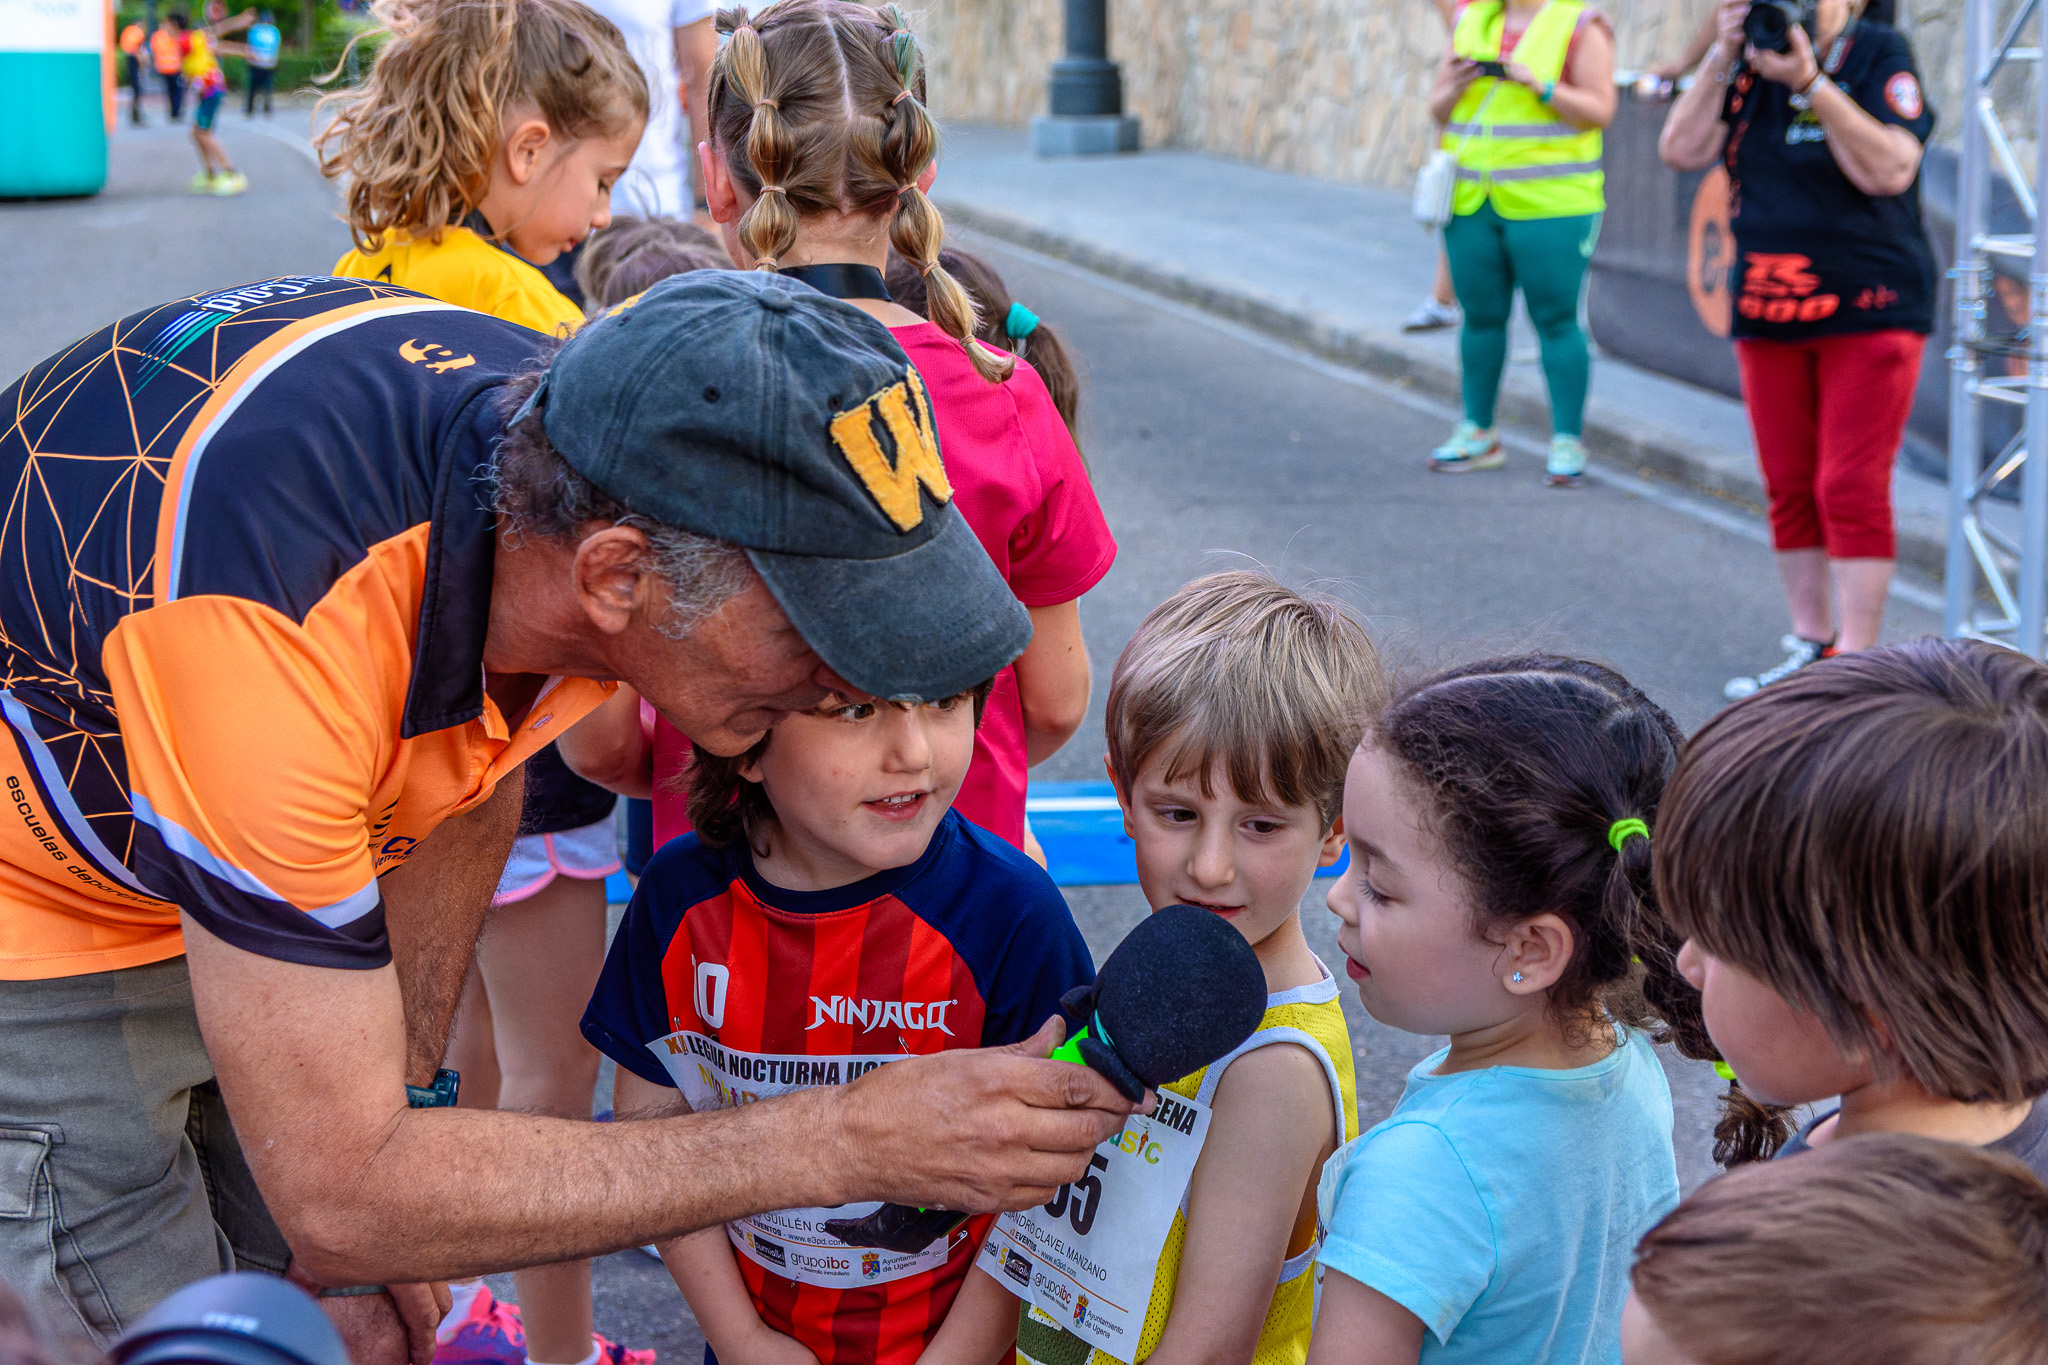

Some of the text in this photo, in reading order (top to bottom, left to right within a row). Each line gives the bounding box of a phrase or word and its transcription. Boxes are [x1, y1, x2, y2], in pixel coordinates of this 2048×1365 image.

[830, 364, 954, 532] W
[6, 775, 68, 861] escuelas
[804, 995, 956, 1037] NINJAGO
[686, 1035, 727, 1073] LEGUA
[728, 1053, 840, 1086] NOCTURNA
[697, 1062, 739, 1107] Night
[752, 1219, 782, 1237] EVENTOS
[763, 1211, 812, 1232] GUILLÉN
[1014, 1231, 1039, 1253] EVENTOS
[1034, 1227, 1065, 1256] CLAVEL
[1065, 1246, 1108, 1282] MANZANO
[790, 1252, 850, 1271] grupoibc
[893, 1260, 918, 1272] Ugena
[1034, 1272, 1072, 1305] grupoibc
[1085, 1320, 1112, 1339] de Ugena
[1086, 1310, 1124, 1335] Ayuntamiento
